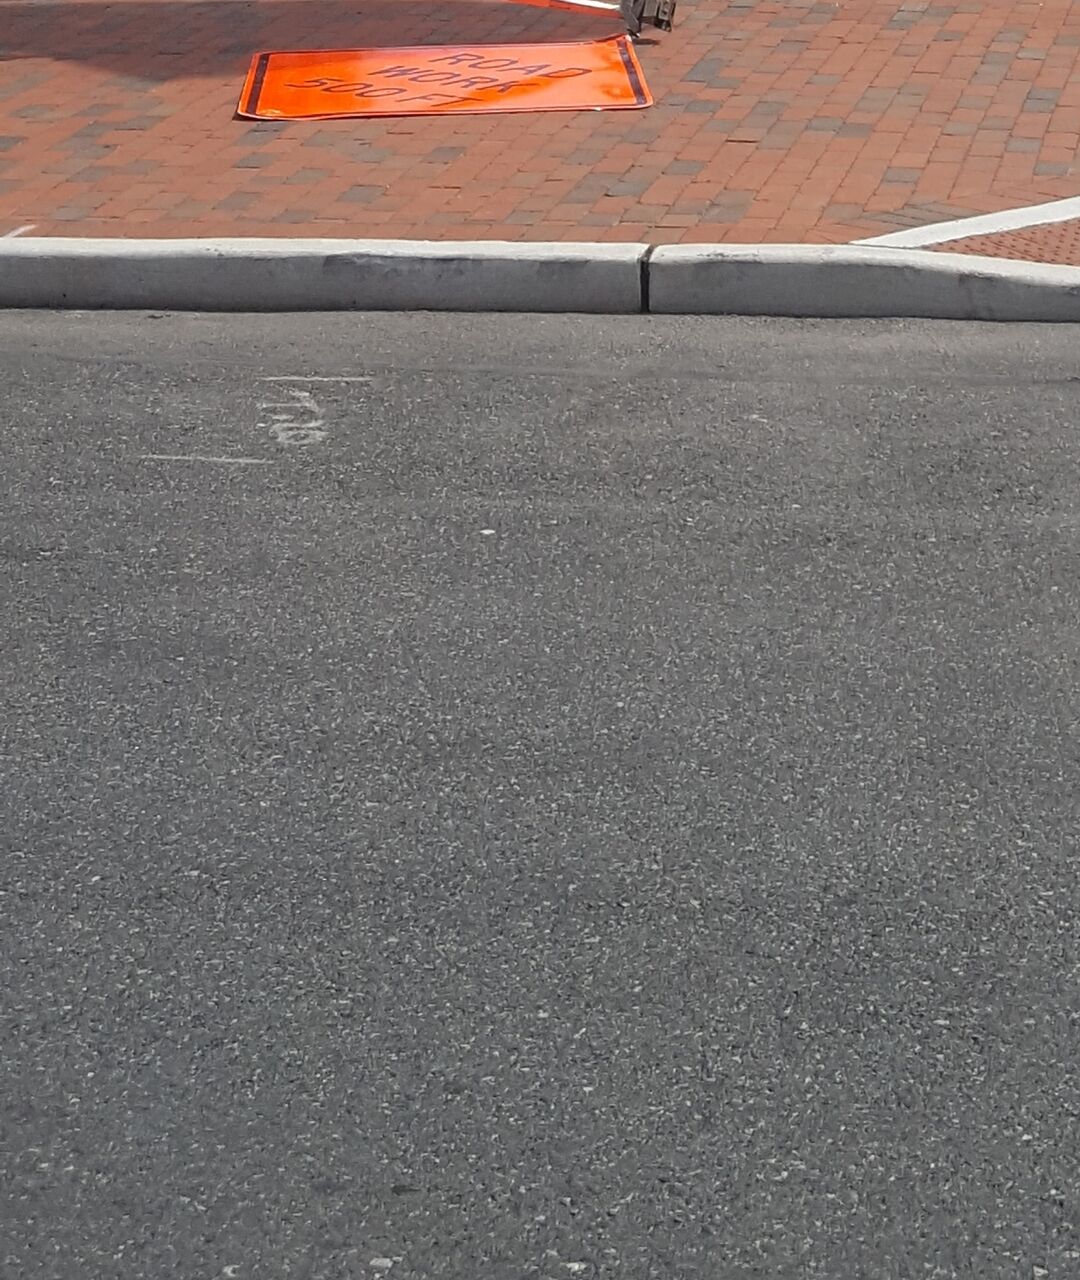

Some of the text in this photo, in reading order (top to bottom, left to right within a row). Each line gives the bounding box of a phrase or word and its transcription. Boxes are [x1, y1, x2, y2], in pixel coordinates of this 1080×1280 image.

[367, 65, 539, 93] WORK
[429, 52, 593, 79] ROAD
[285, 77, 485, 108] 500 FT
